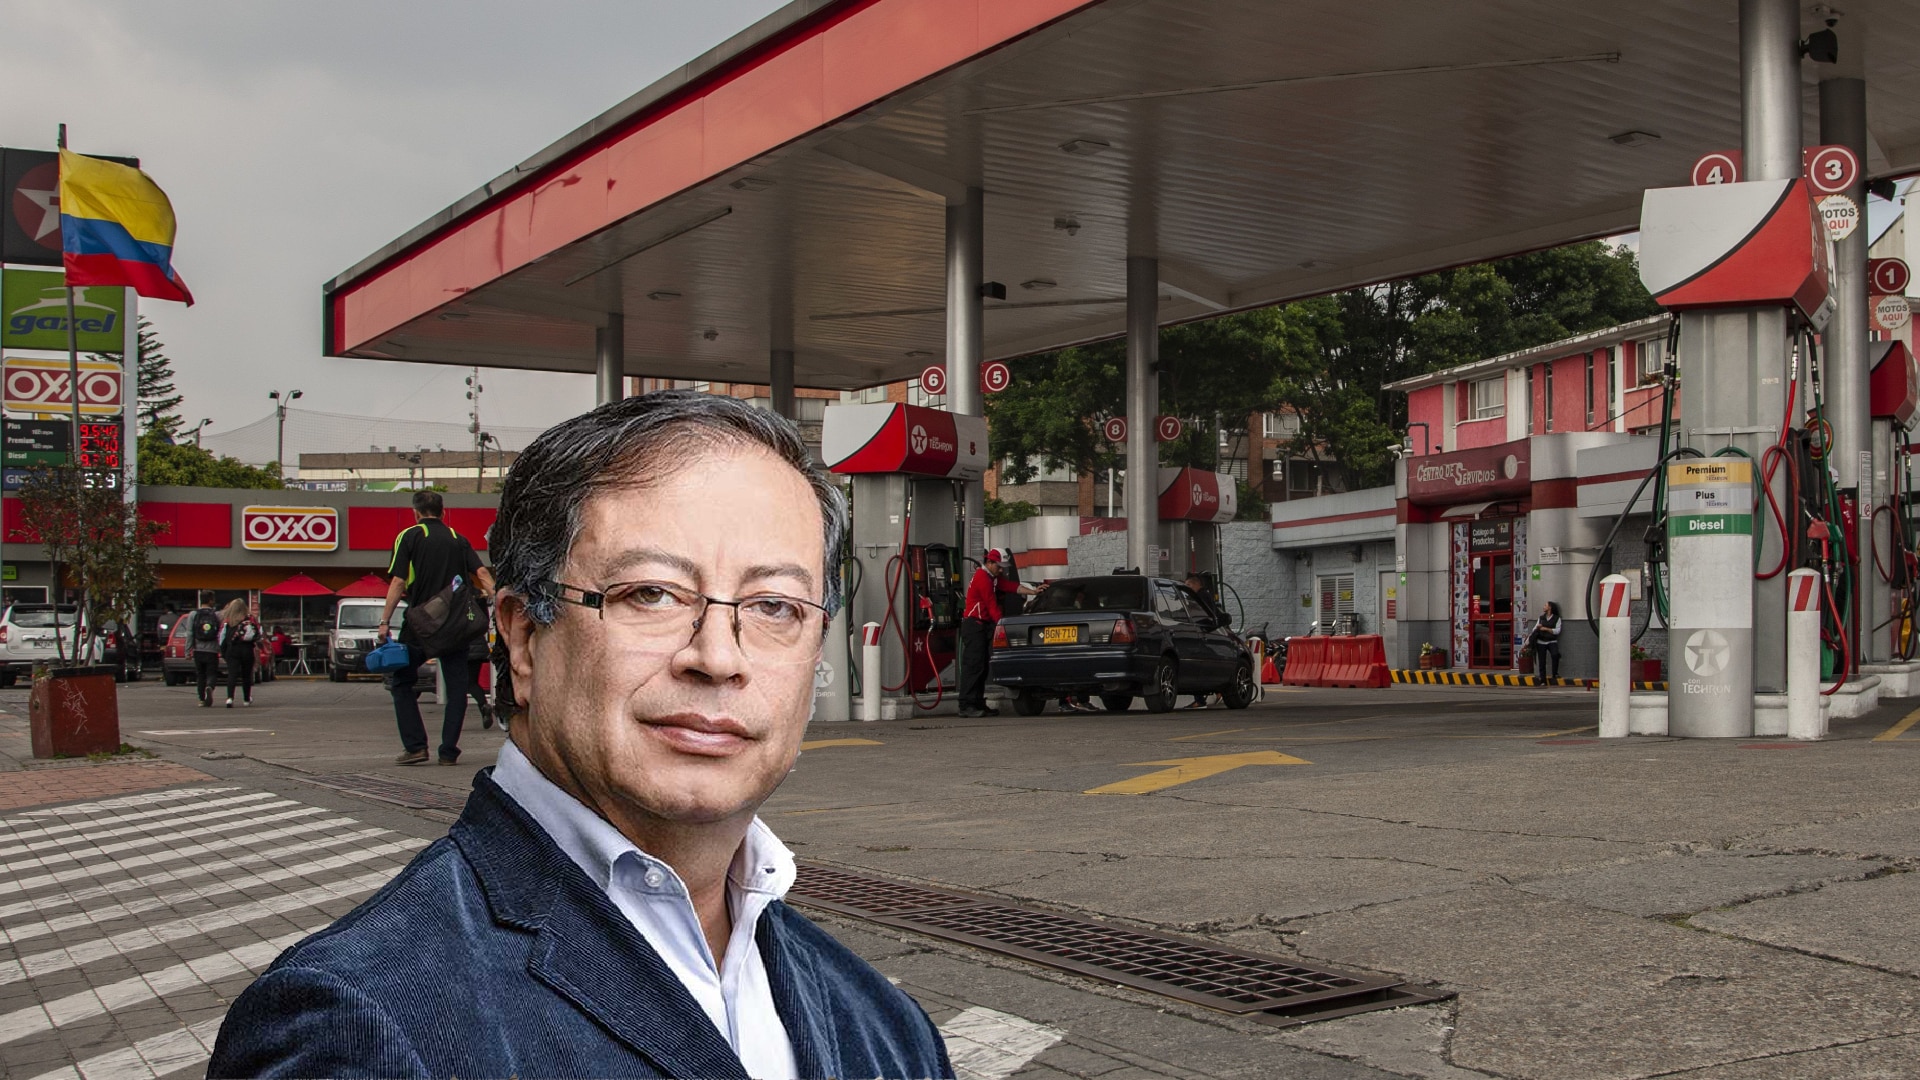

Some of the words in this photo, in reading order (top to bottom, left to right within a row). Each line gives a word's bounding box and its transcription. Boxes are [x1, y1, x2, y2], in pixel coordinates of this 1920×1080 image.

[1706, 165, 1724, 185] 4
[1824, 159, 1842, 181] 3
[1829, 219, 1849, 230] QUI
[1885, 268, 1895, 284] 1
[1877, 304, 1908, 313] MOTOS
[9, 313, 117, 335] gazel
[1882, 313, 1903, 321] AQUI
[928, 373, 939, 387] 6
[992, 370, 1002, 384] 5
[7, 370, 118, 403] OXXO
[7, 422, 21, 430] Plus
[1111, 424, 1120, 435] 8
[1166, 422, 1175, 434] 7
[1444, 463, 1455, 477] DE
[1686, 465, 1726, 474] Premium
[1695, 491, 1715, 500] Plus
[249, 515, 332, 541] OXXO
[1689, 519, 1724, 530] Diesel
[1682, 682, 1731, 696] TECHRON
